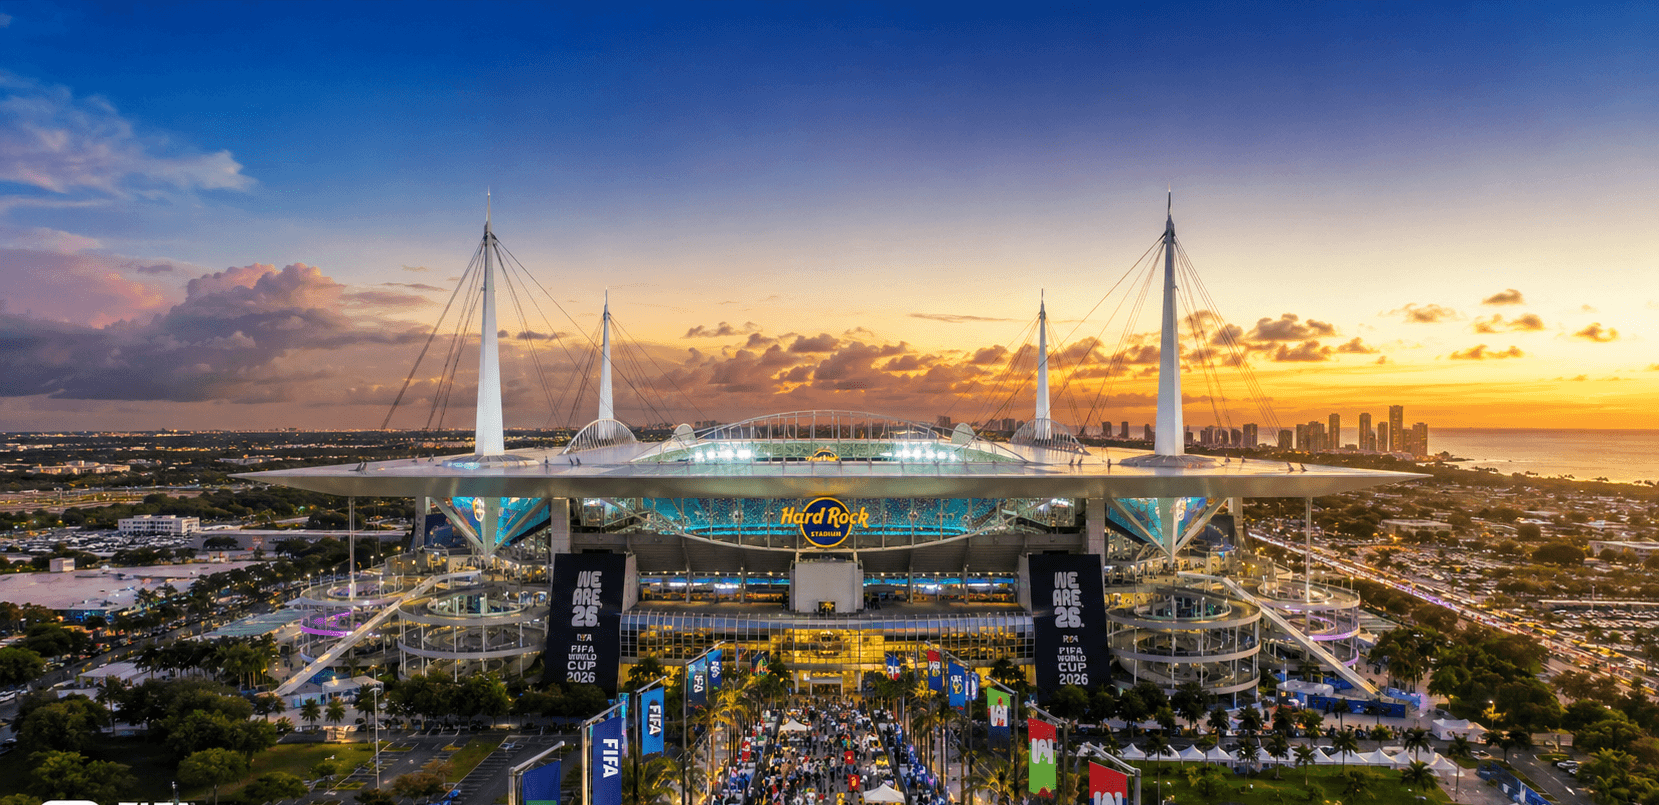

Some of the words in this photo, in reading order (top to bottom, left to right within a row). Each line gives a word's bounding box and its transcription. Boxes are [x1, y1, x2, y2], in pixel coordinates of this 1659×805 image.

[780, 506, 826, 525] Hard
[827, 506, 870, 529] Rock
[577, 570, 602, 588] WE
[1054, 571, 1080, 589] WE
[571, 645, 595, 653] FIFA
[567, 661, 597, 671] CUP
[1058, 662, 1087, 672] CUP
[566, 671, 596, 684] 2026
[1059, 673, 1089, 686] 2026
[649, 705, 662, 735] FIFA
[602, 738, 619, 778] FIFA
